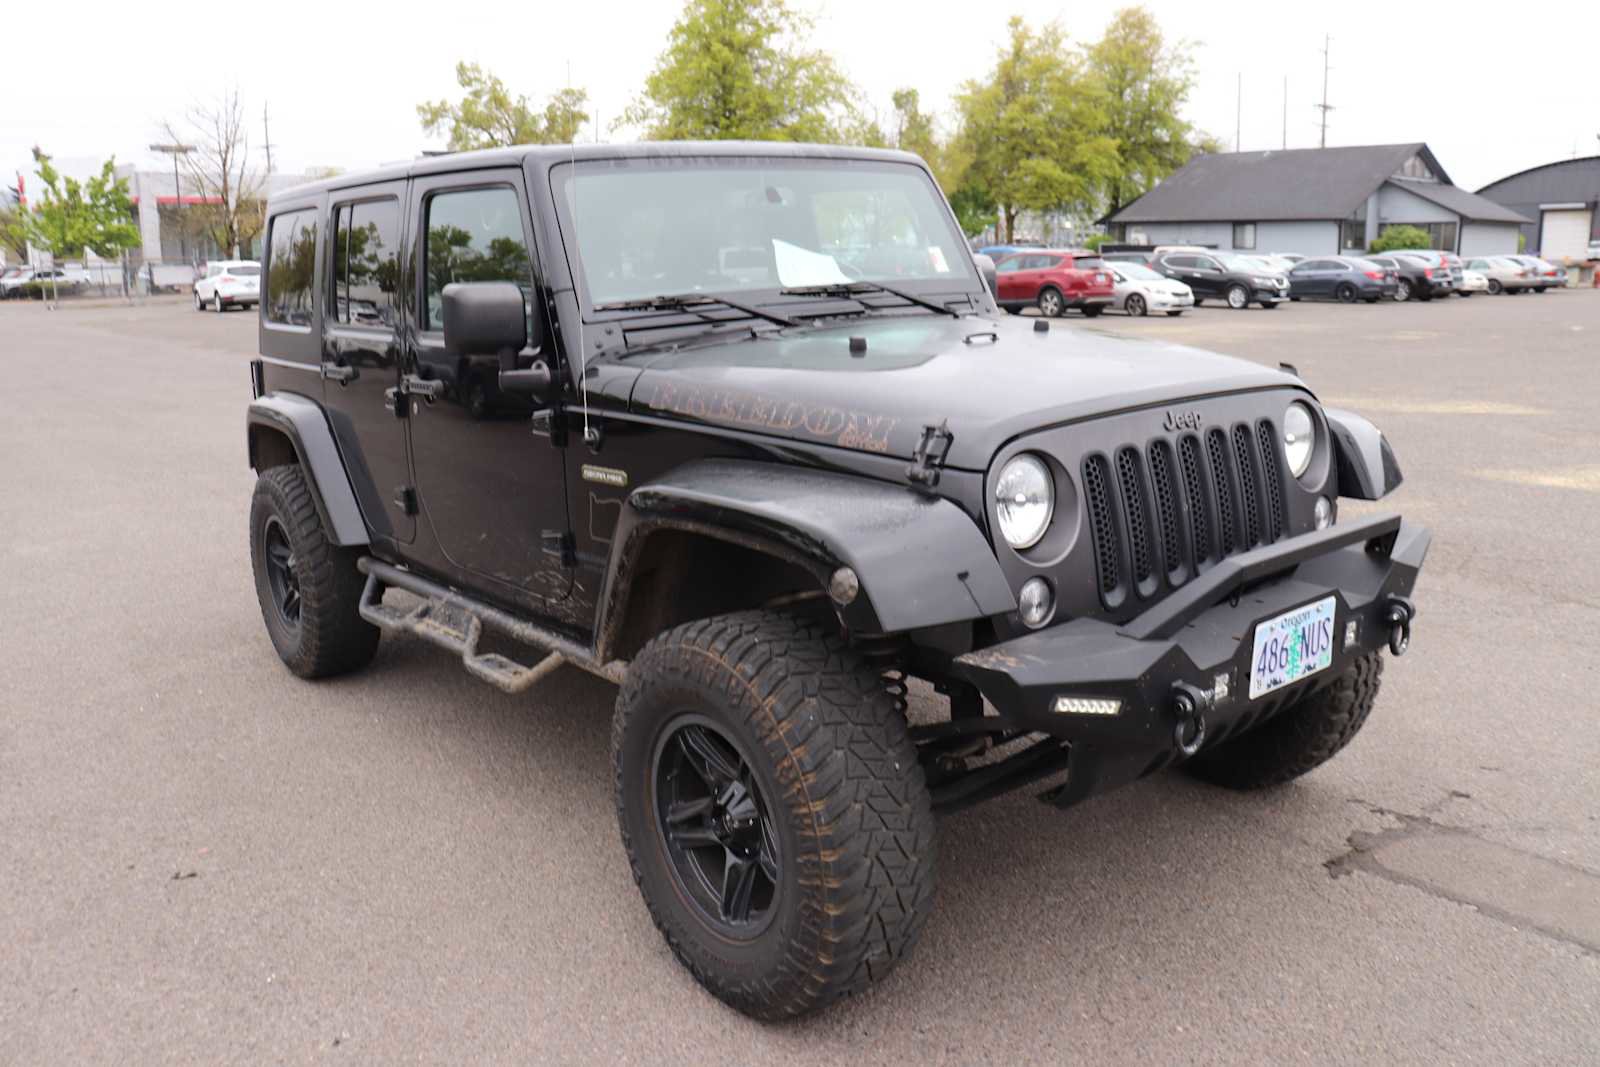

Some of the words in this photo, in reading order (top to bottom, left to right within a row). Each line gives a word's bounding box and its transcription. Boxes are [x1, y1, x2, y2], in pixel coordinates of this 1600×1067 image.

[1163, 410, 1203, 433] Jeep
[1281, 612, 1312, 630] Oregon
[1257, 634, 1290, 678] 486
[1299, 617, 1331, 662] NUS
